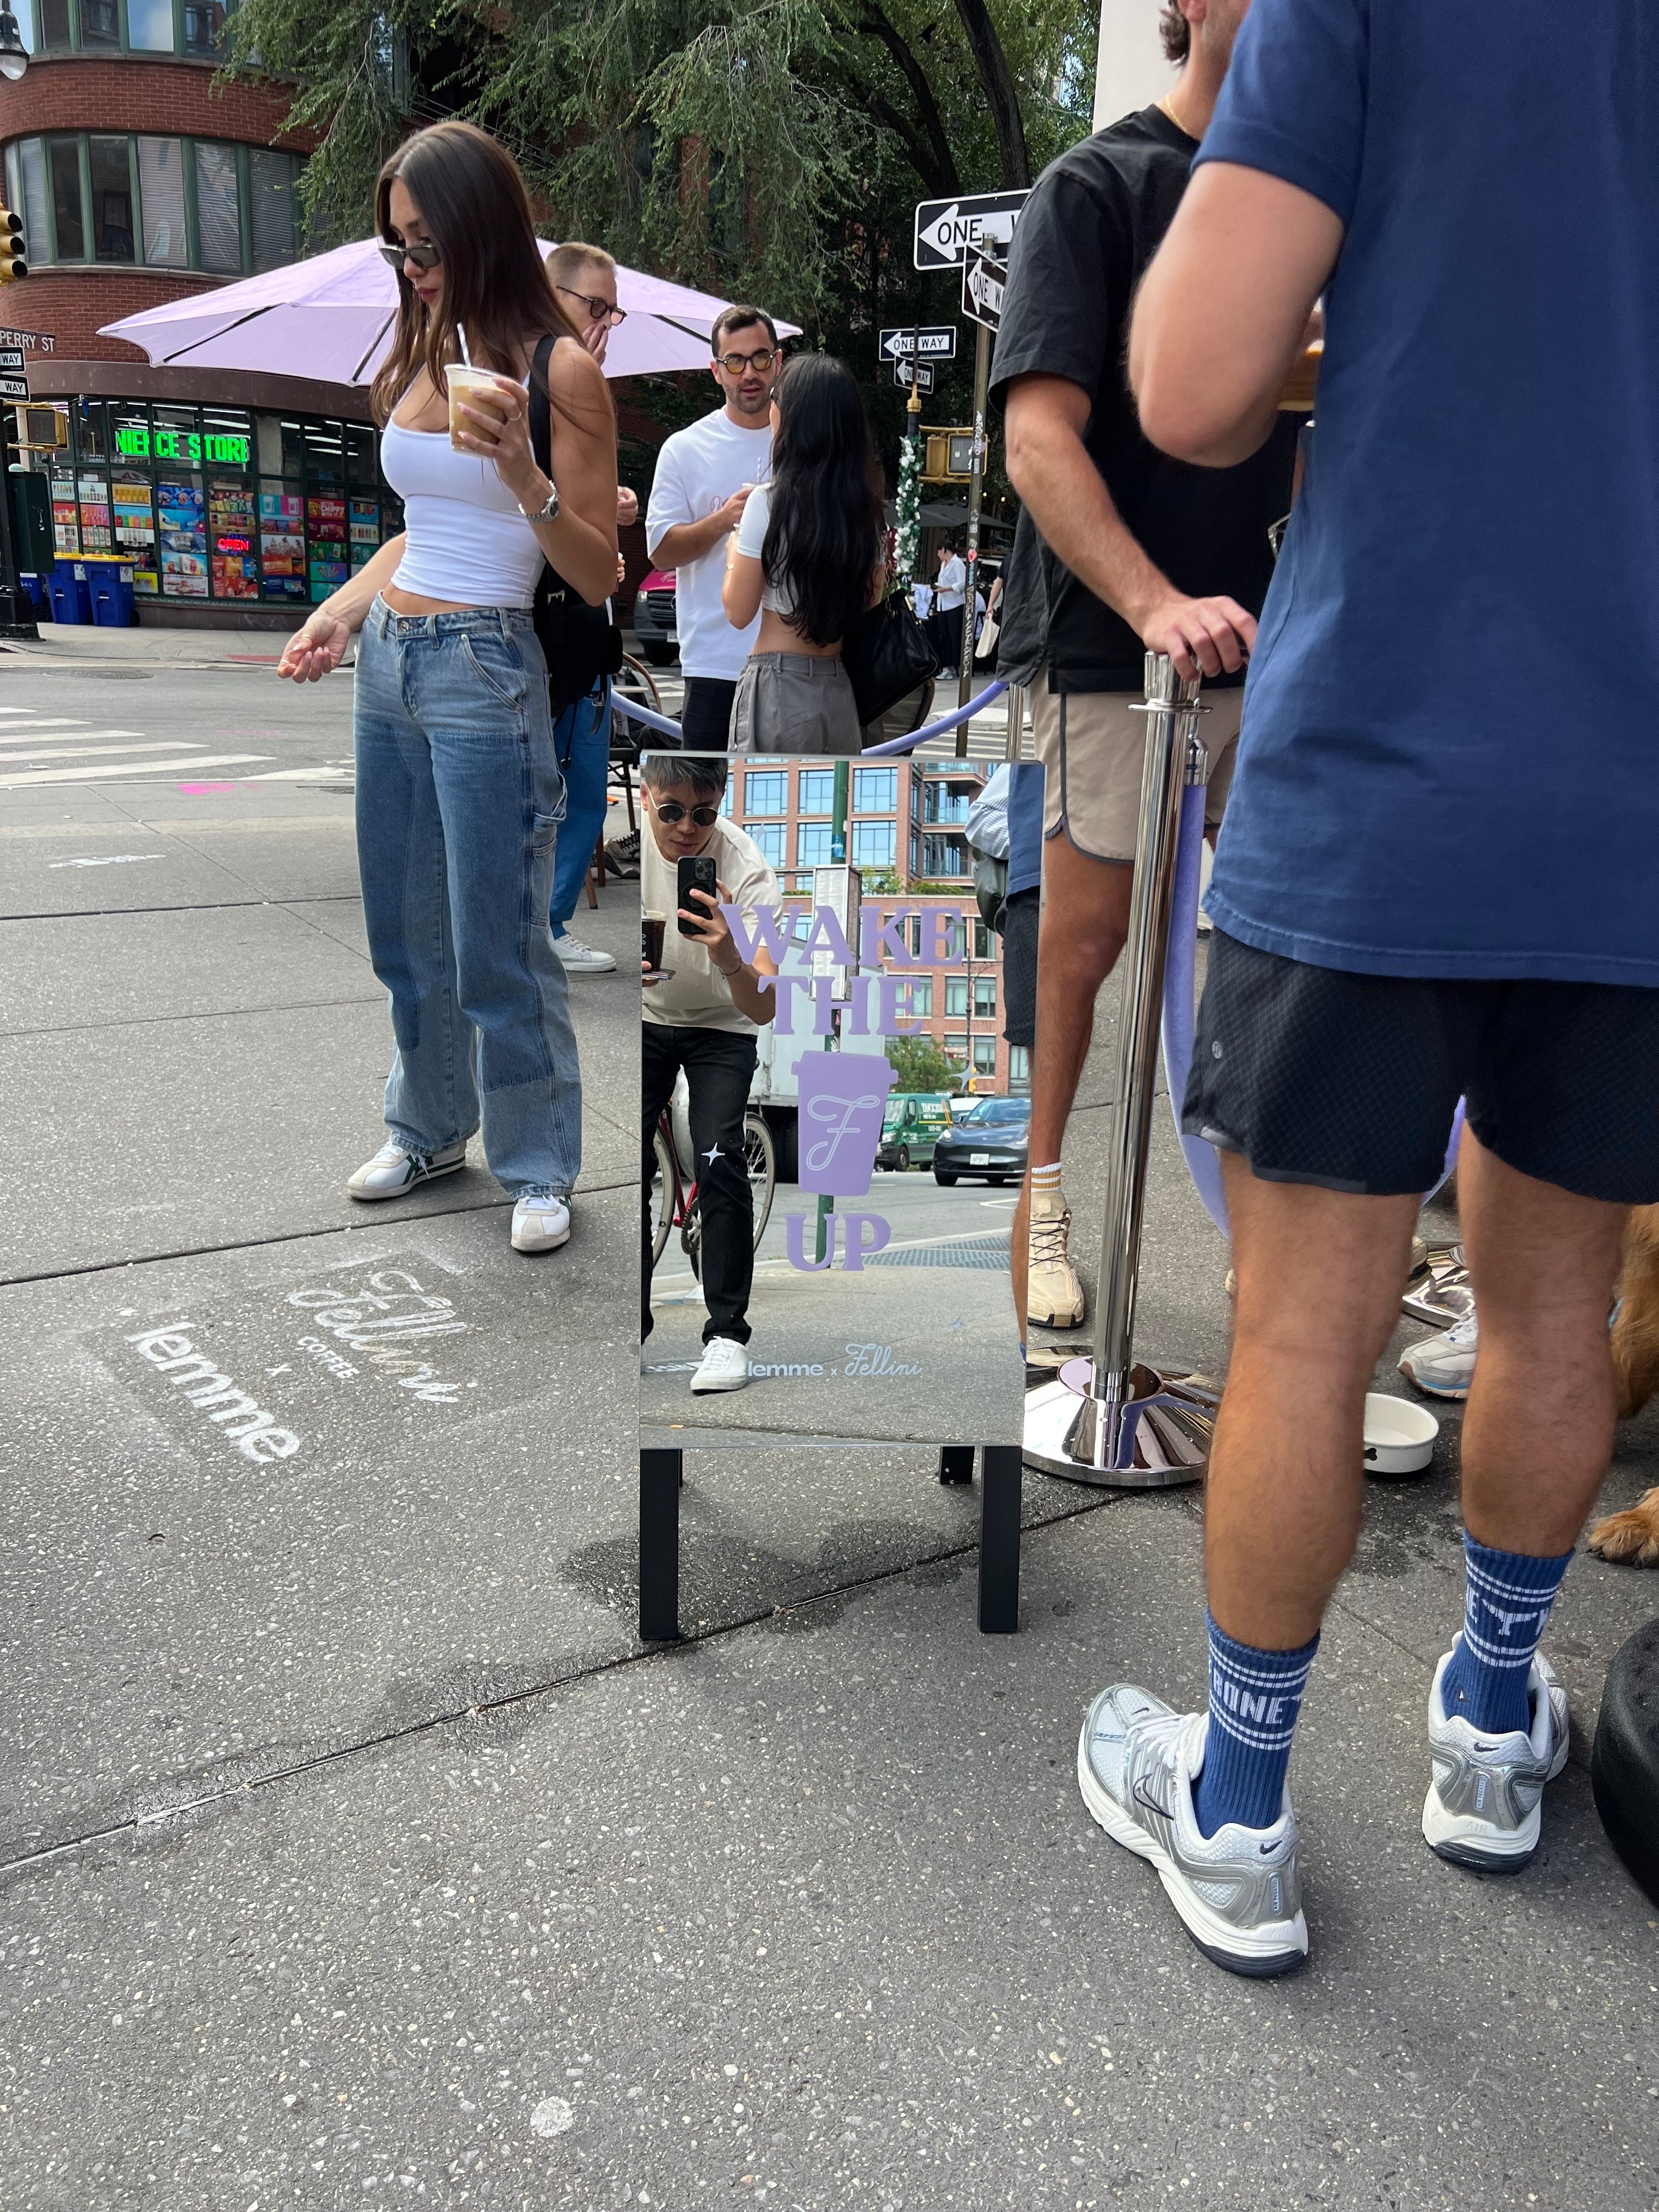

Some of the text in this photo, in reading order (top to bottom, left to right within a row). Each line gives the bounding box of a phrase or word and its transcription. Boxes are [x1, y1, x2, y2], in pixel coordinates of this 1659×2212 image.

[938, 218, 983, 245] ONE
[973, 272, 989, 303] ONE
[0, 330, 54, 352] PERRY ST
[894, 337, 944, 350] ONE WAY
[2, 354, 19, 364] WAY
[904, 367, 913, 380] ON
[5, 382, 23, 393] WAY
[188, 435, 248, 462] STORE
[217, 538, 249, 551] OPEN
[718, 904, 964, 967] WAKE
[757, 975, 923, 1036] THE
[806, 1094, 881, 1171] F
[784, 1213, 891, 1272] UP
[297, 1336, 360, 1379] COFFEE
[748, 1361, 823, 1377] lemme
[844, 1343, 924, 1376] Fellini
[123, 1321, 301, 1464] lemme
[1465, 1821, 1487, 1832] AIR
